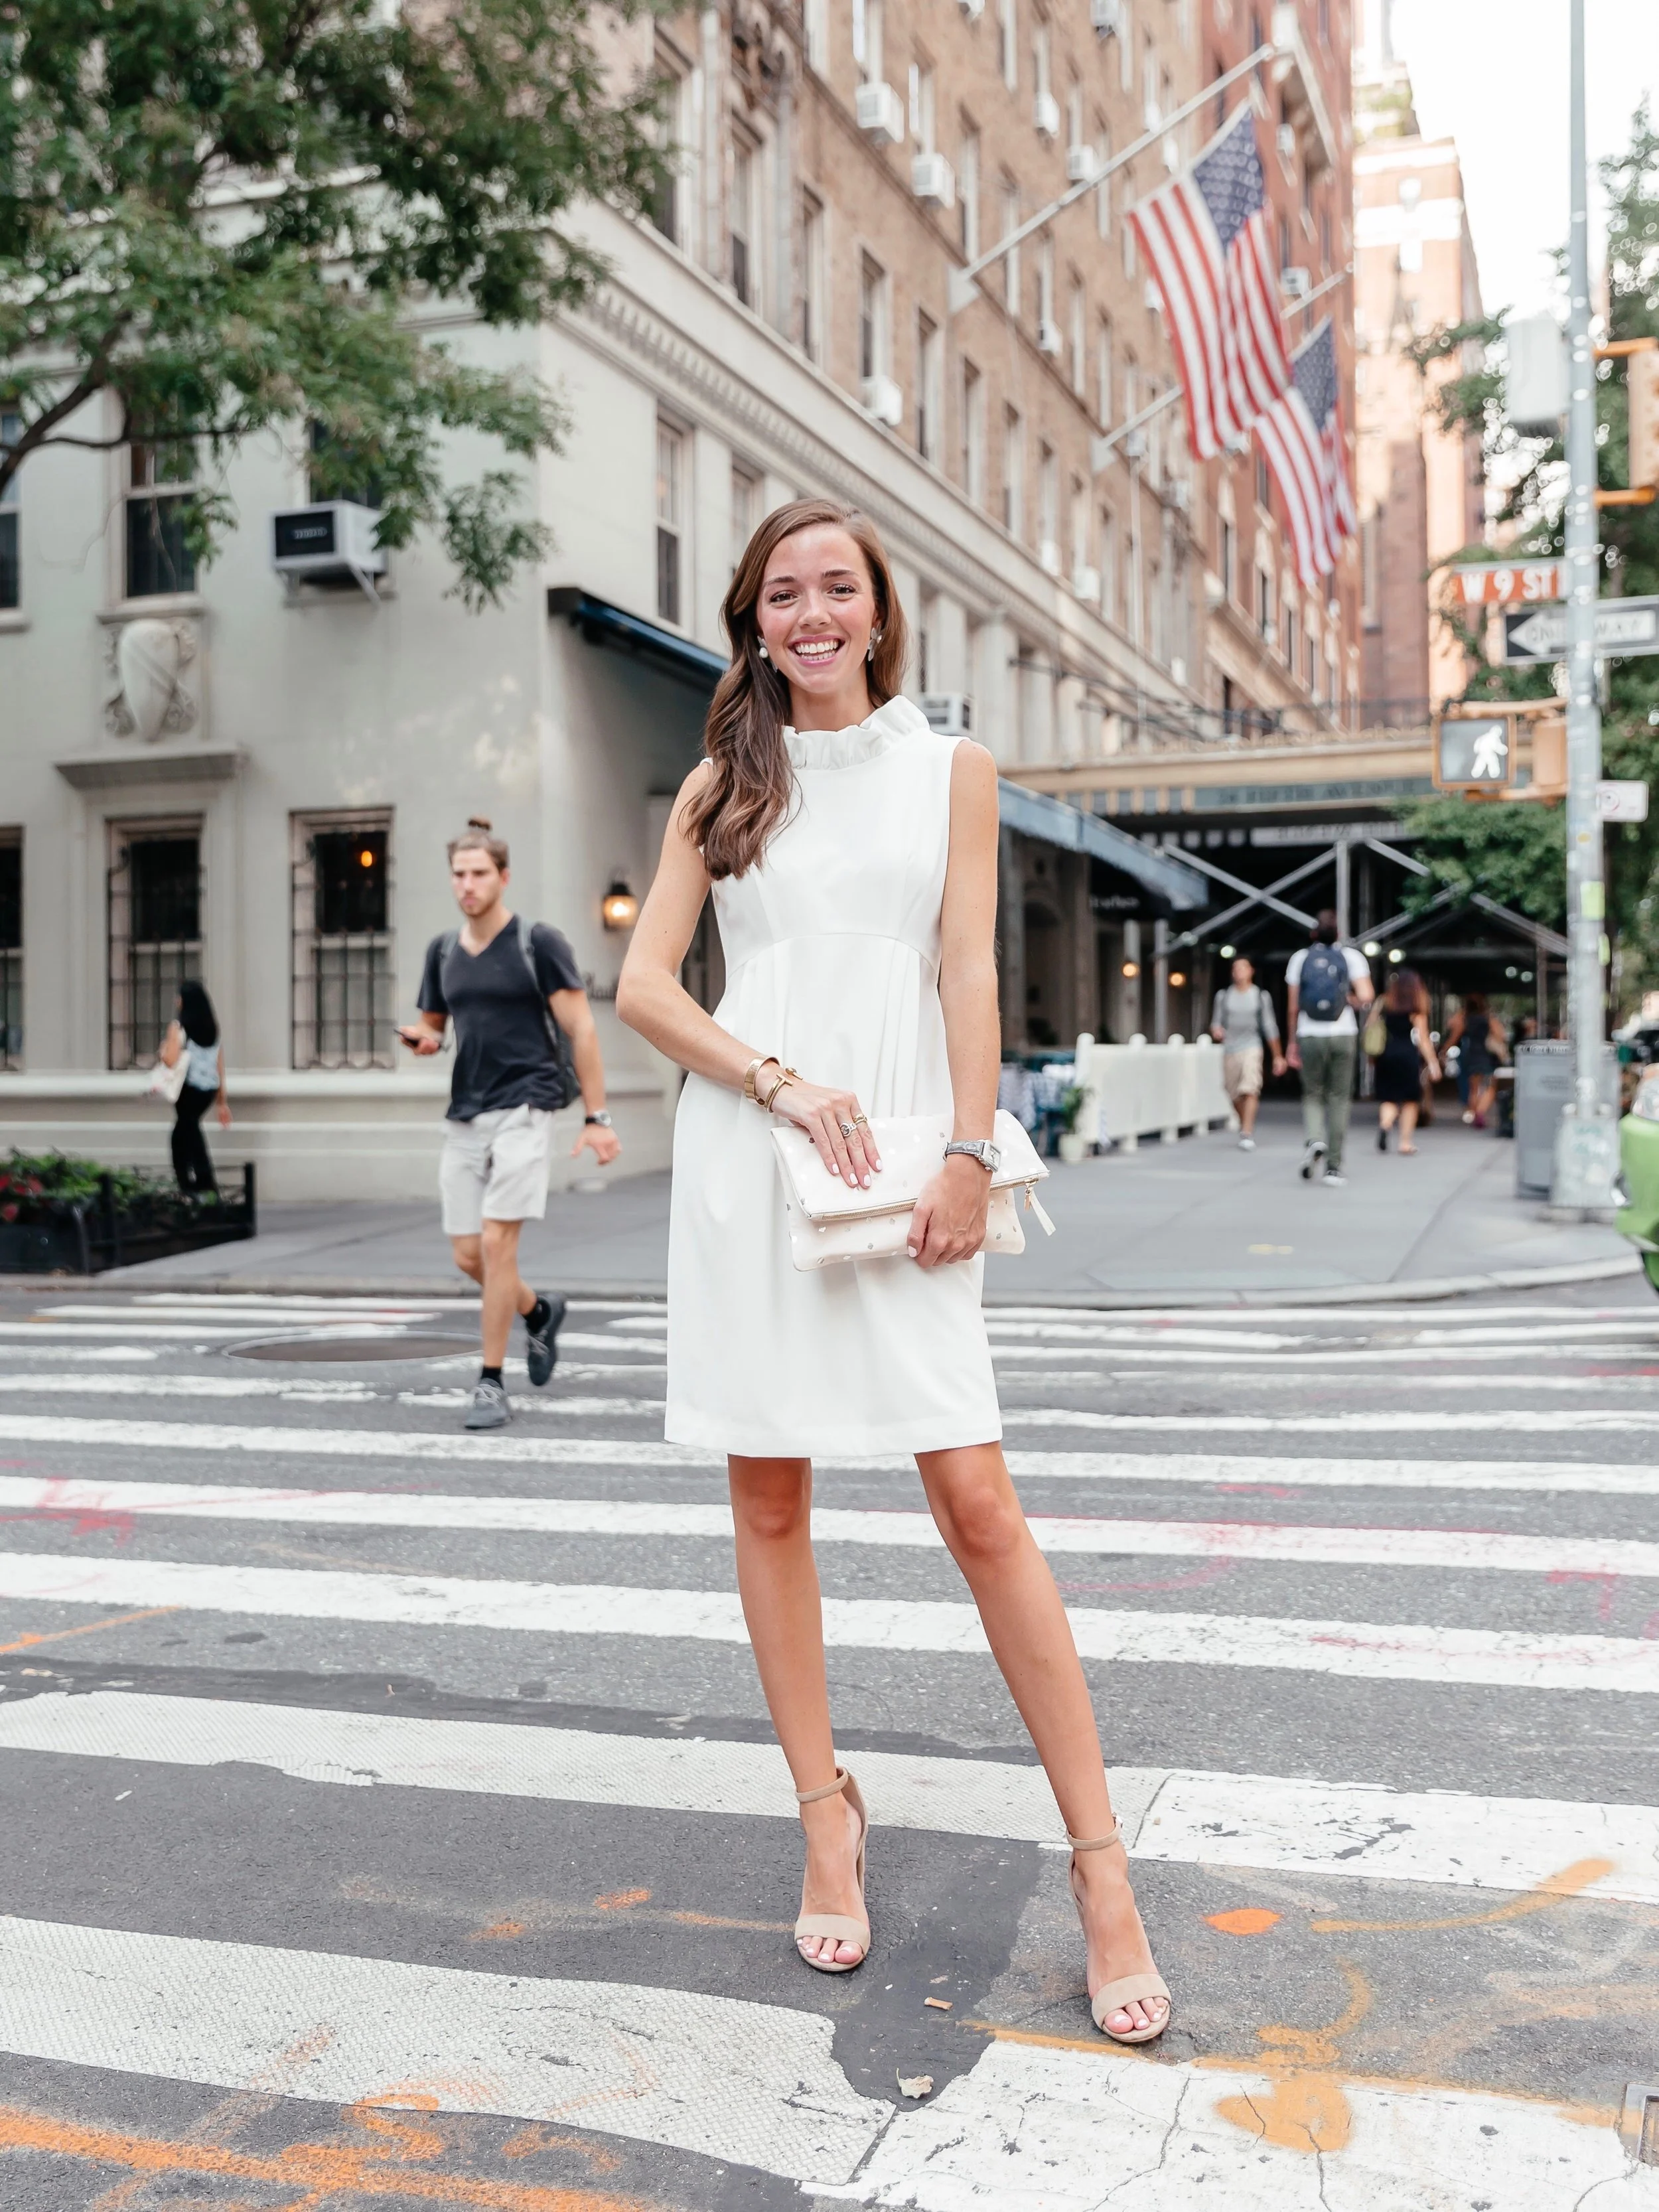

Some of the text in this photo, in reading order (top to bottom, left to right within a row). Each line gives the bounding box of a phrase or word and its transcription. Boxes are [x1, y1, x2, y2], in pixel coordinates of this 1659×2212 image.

[1461, 566, 1553, 603] W 9 ST
